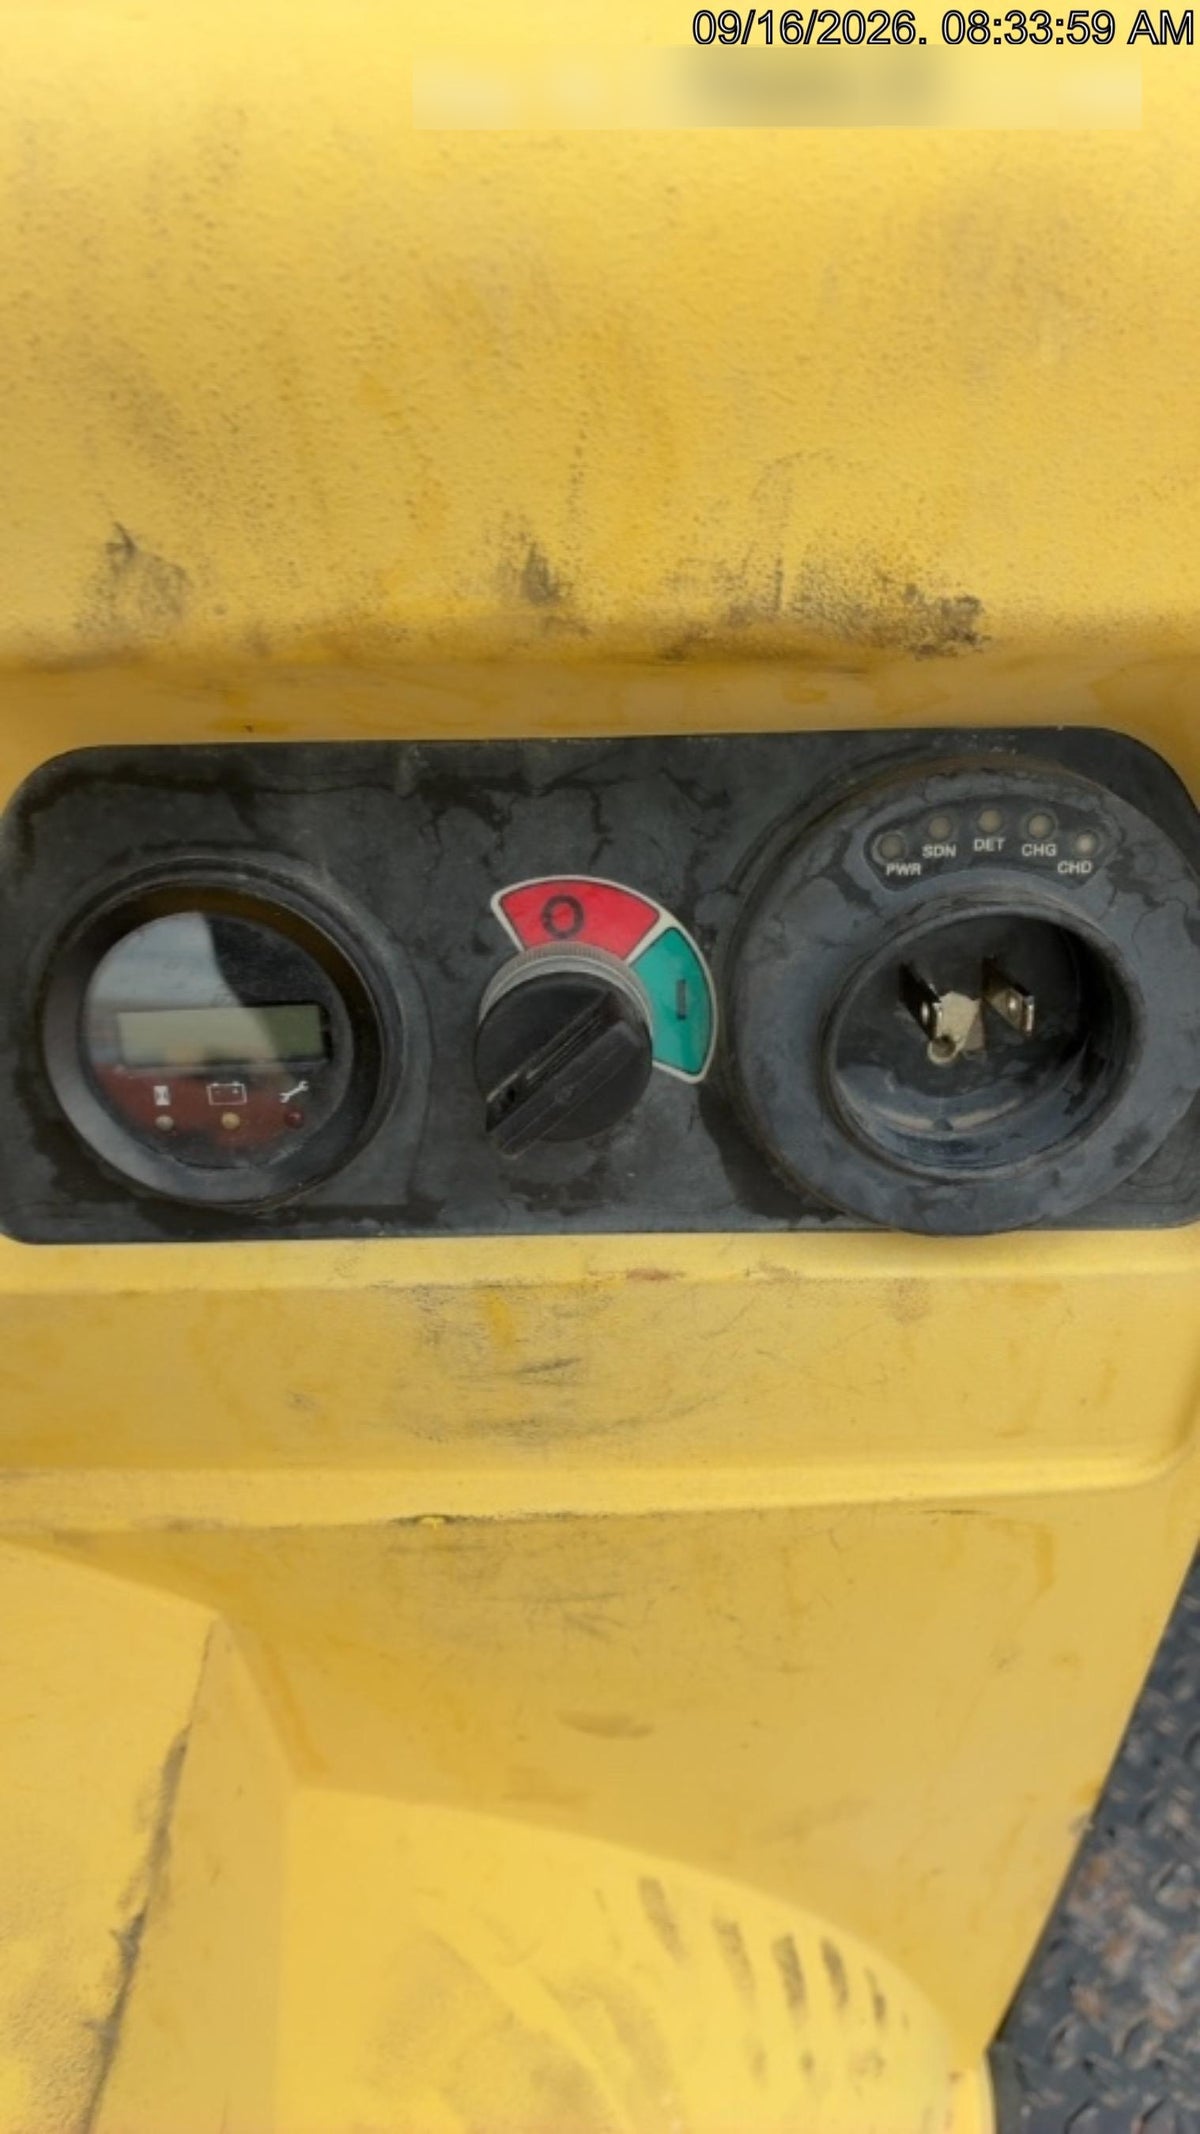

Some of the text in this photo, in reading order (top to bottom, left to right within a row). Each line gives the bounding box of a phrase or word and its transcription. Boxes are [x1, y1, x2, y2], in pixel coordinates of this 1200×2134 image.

[973, 838, 1005, 851] DET
[1021, 844, 1056, 857] CHG
[922, 845, 956, 858] SDN
[886, 863, 921, 876] PWR
[1057, 861, 1092, 874] CHD
